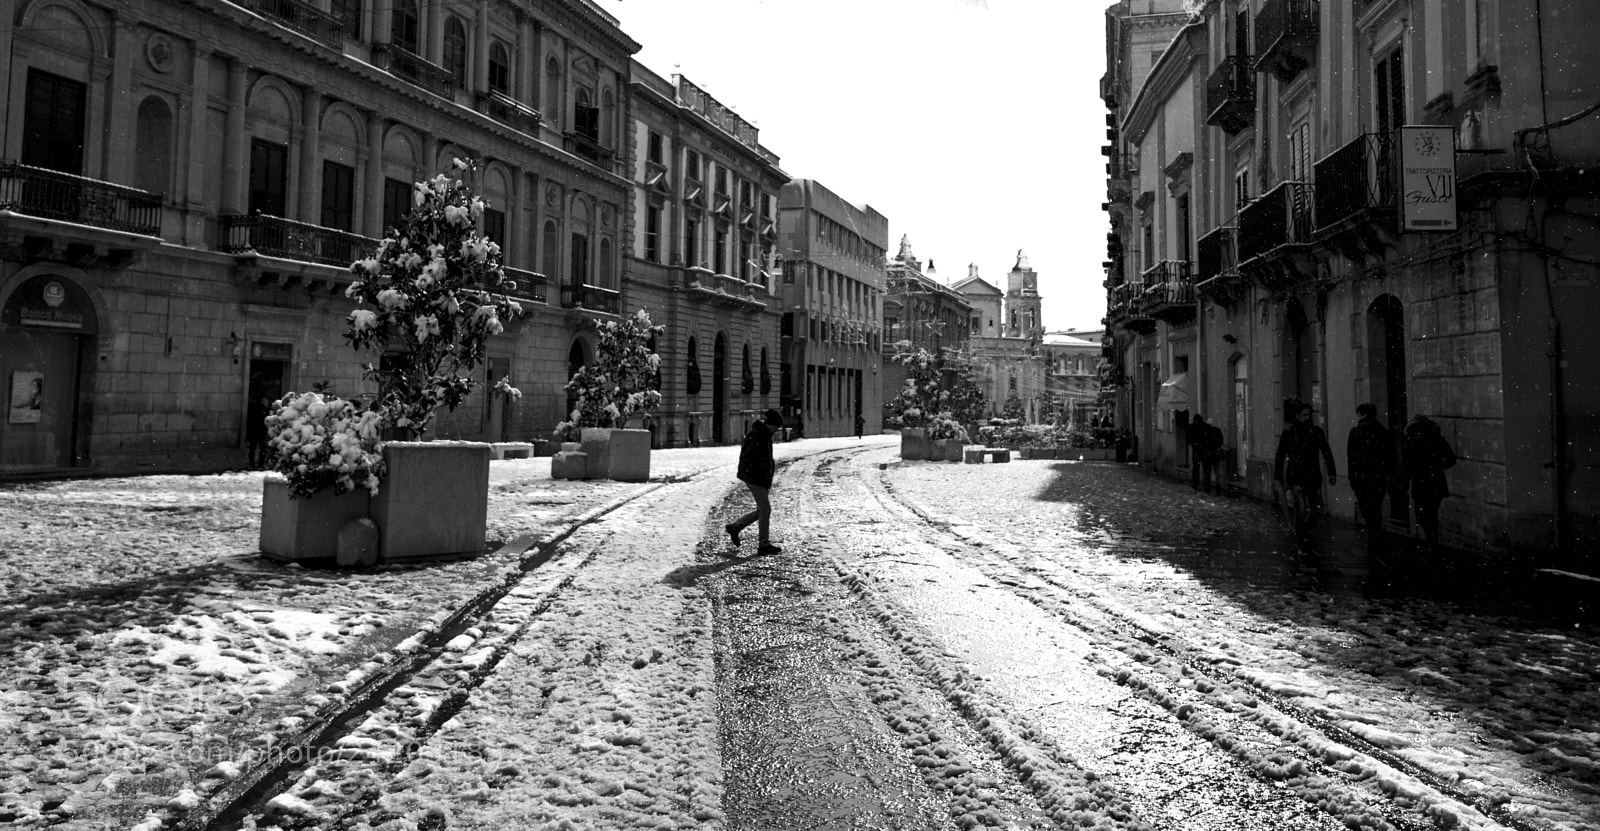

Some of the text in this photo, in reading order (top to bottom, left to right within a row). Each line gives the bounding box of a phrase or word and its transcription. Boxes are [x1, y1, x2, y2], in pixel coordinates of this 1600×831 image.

[1425, 175, 1454, 198] VII
[1405, 190, 1451, 205] Gusto
[20, 307, 84, 322] Banca Nuova
